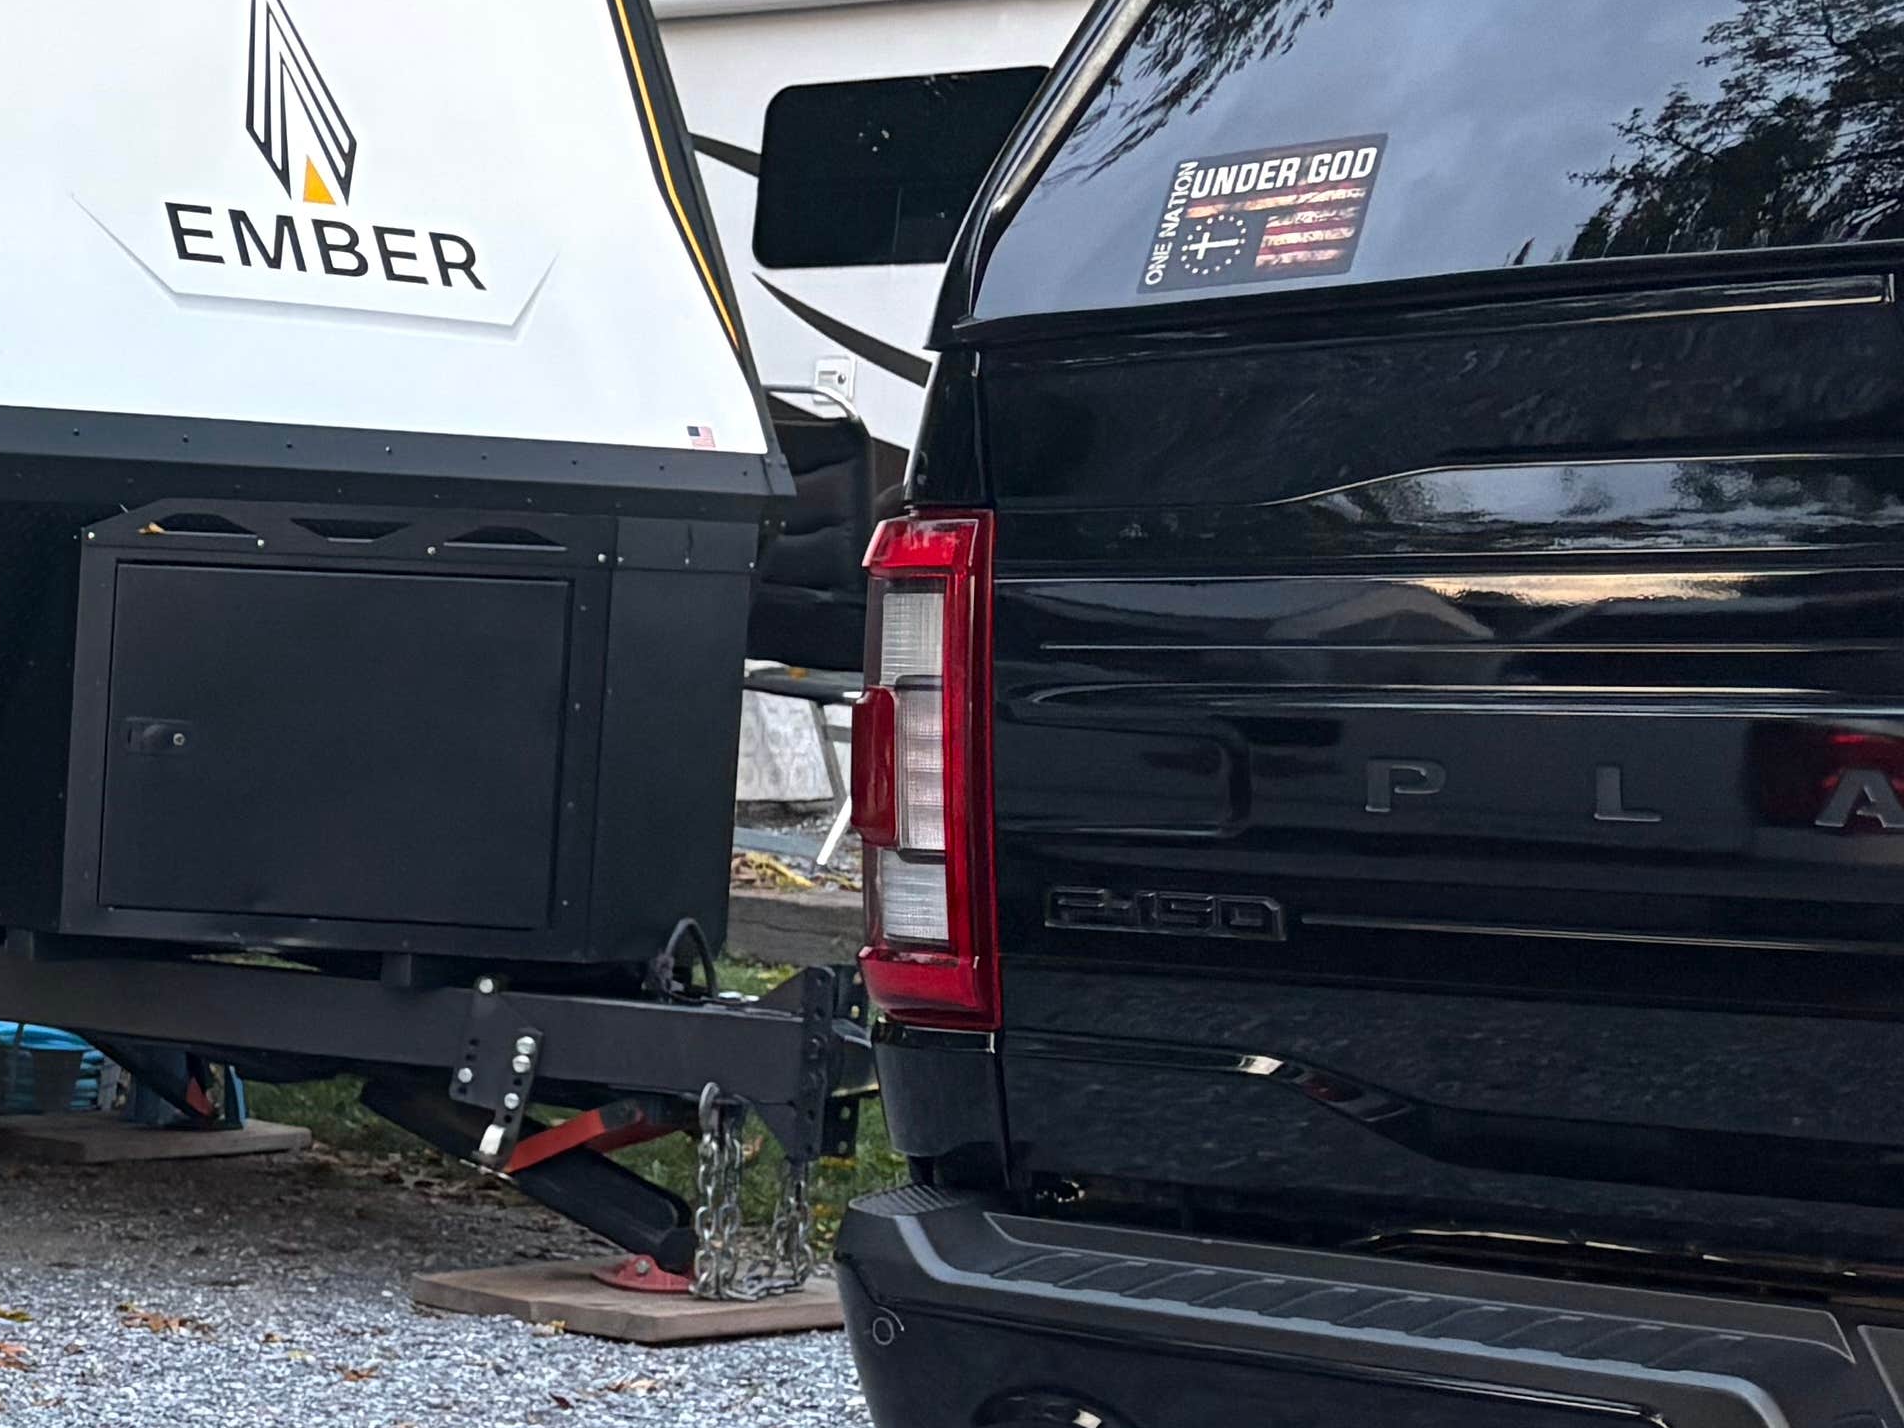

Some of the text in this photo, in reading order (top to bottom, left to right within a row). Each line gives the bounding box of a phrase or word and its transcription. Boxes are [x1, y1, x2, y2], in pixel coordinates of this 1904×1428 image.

[1191, 146, 1378, 199] UNDER GOD
[164, 201, 487, 291] EMBER
[1144, 160, 1199, 286] ONE NATION
